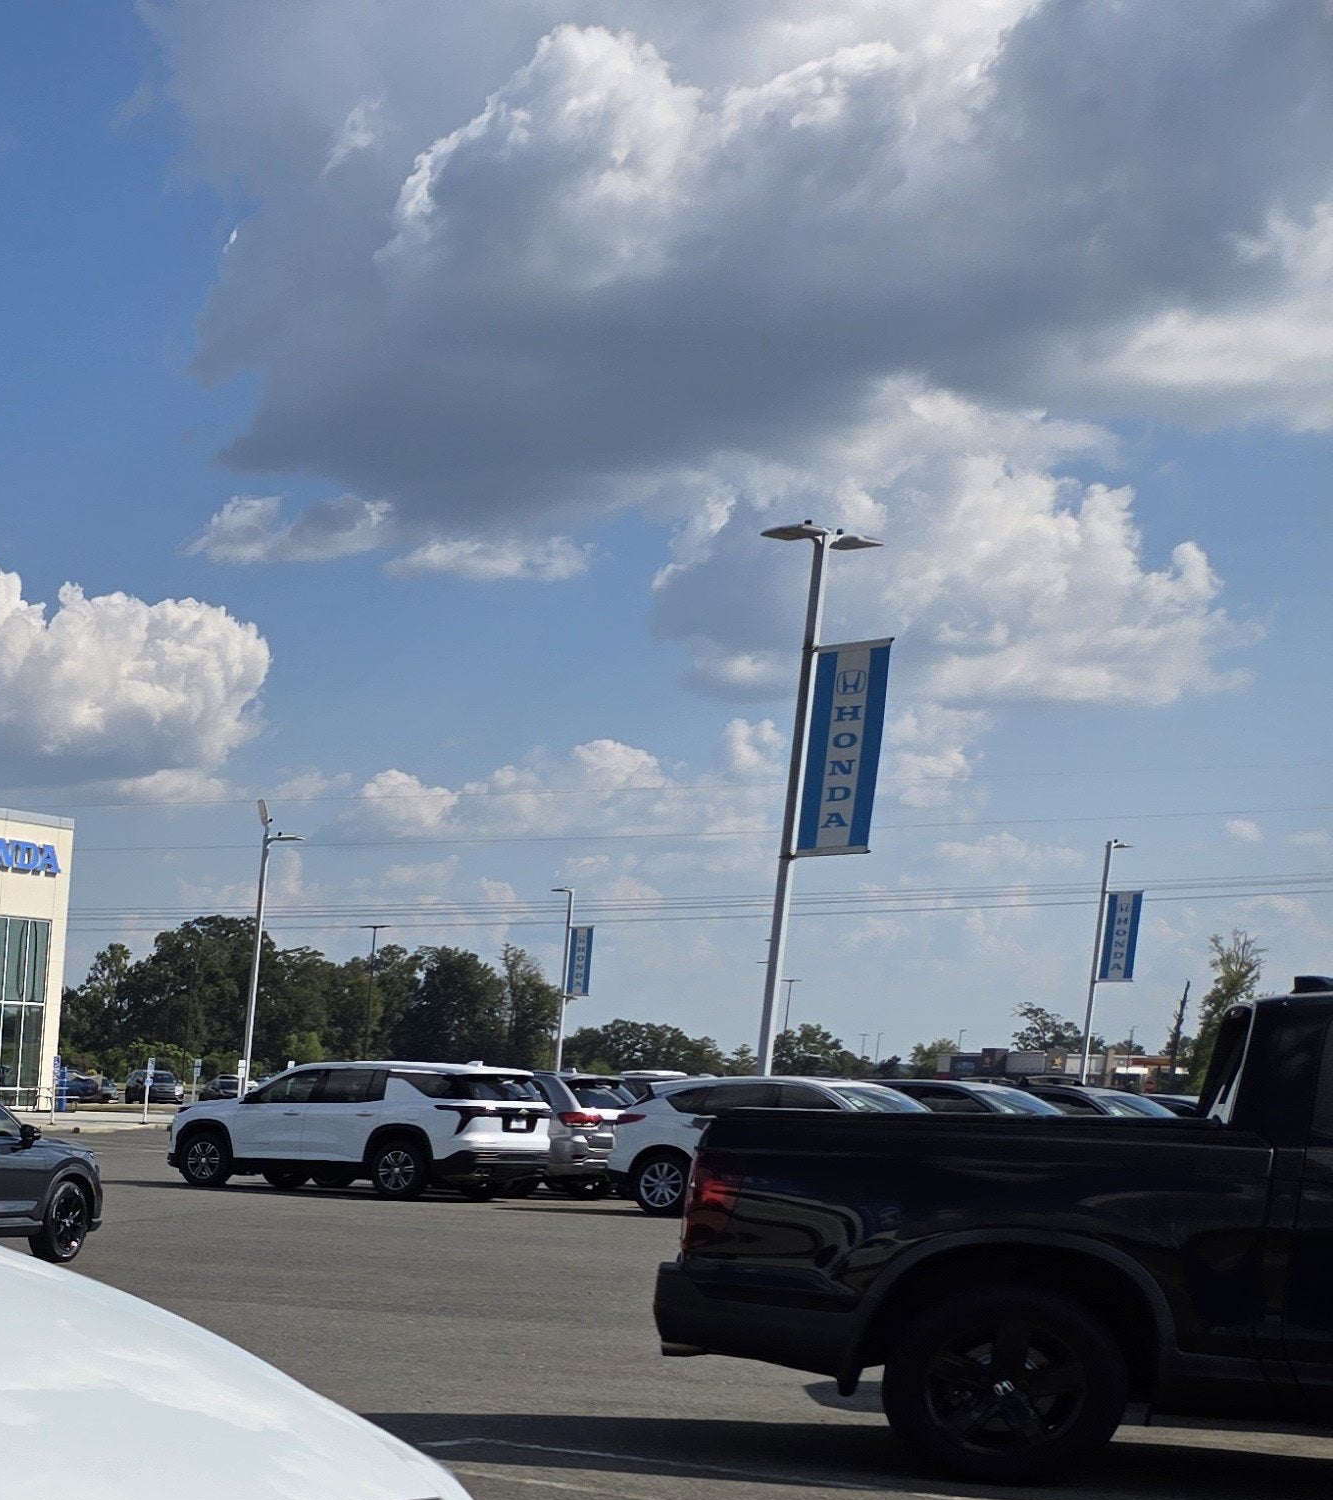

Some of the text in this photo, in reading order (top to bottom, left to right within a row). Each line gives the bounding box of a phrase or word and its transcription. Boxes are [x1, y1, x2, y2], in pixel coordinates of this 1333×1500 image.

[820, 704, 862, 829] HONDA
[573, 946, 586, 987] HONDA
[1110, 916, 1129, 971] HONDA
